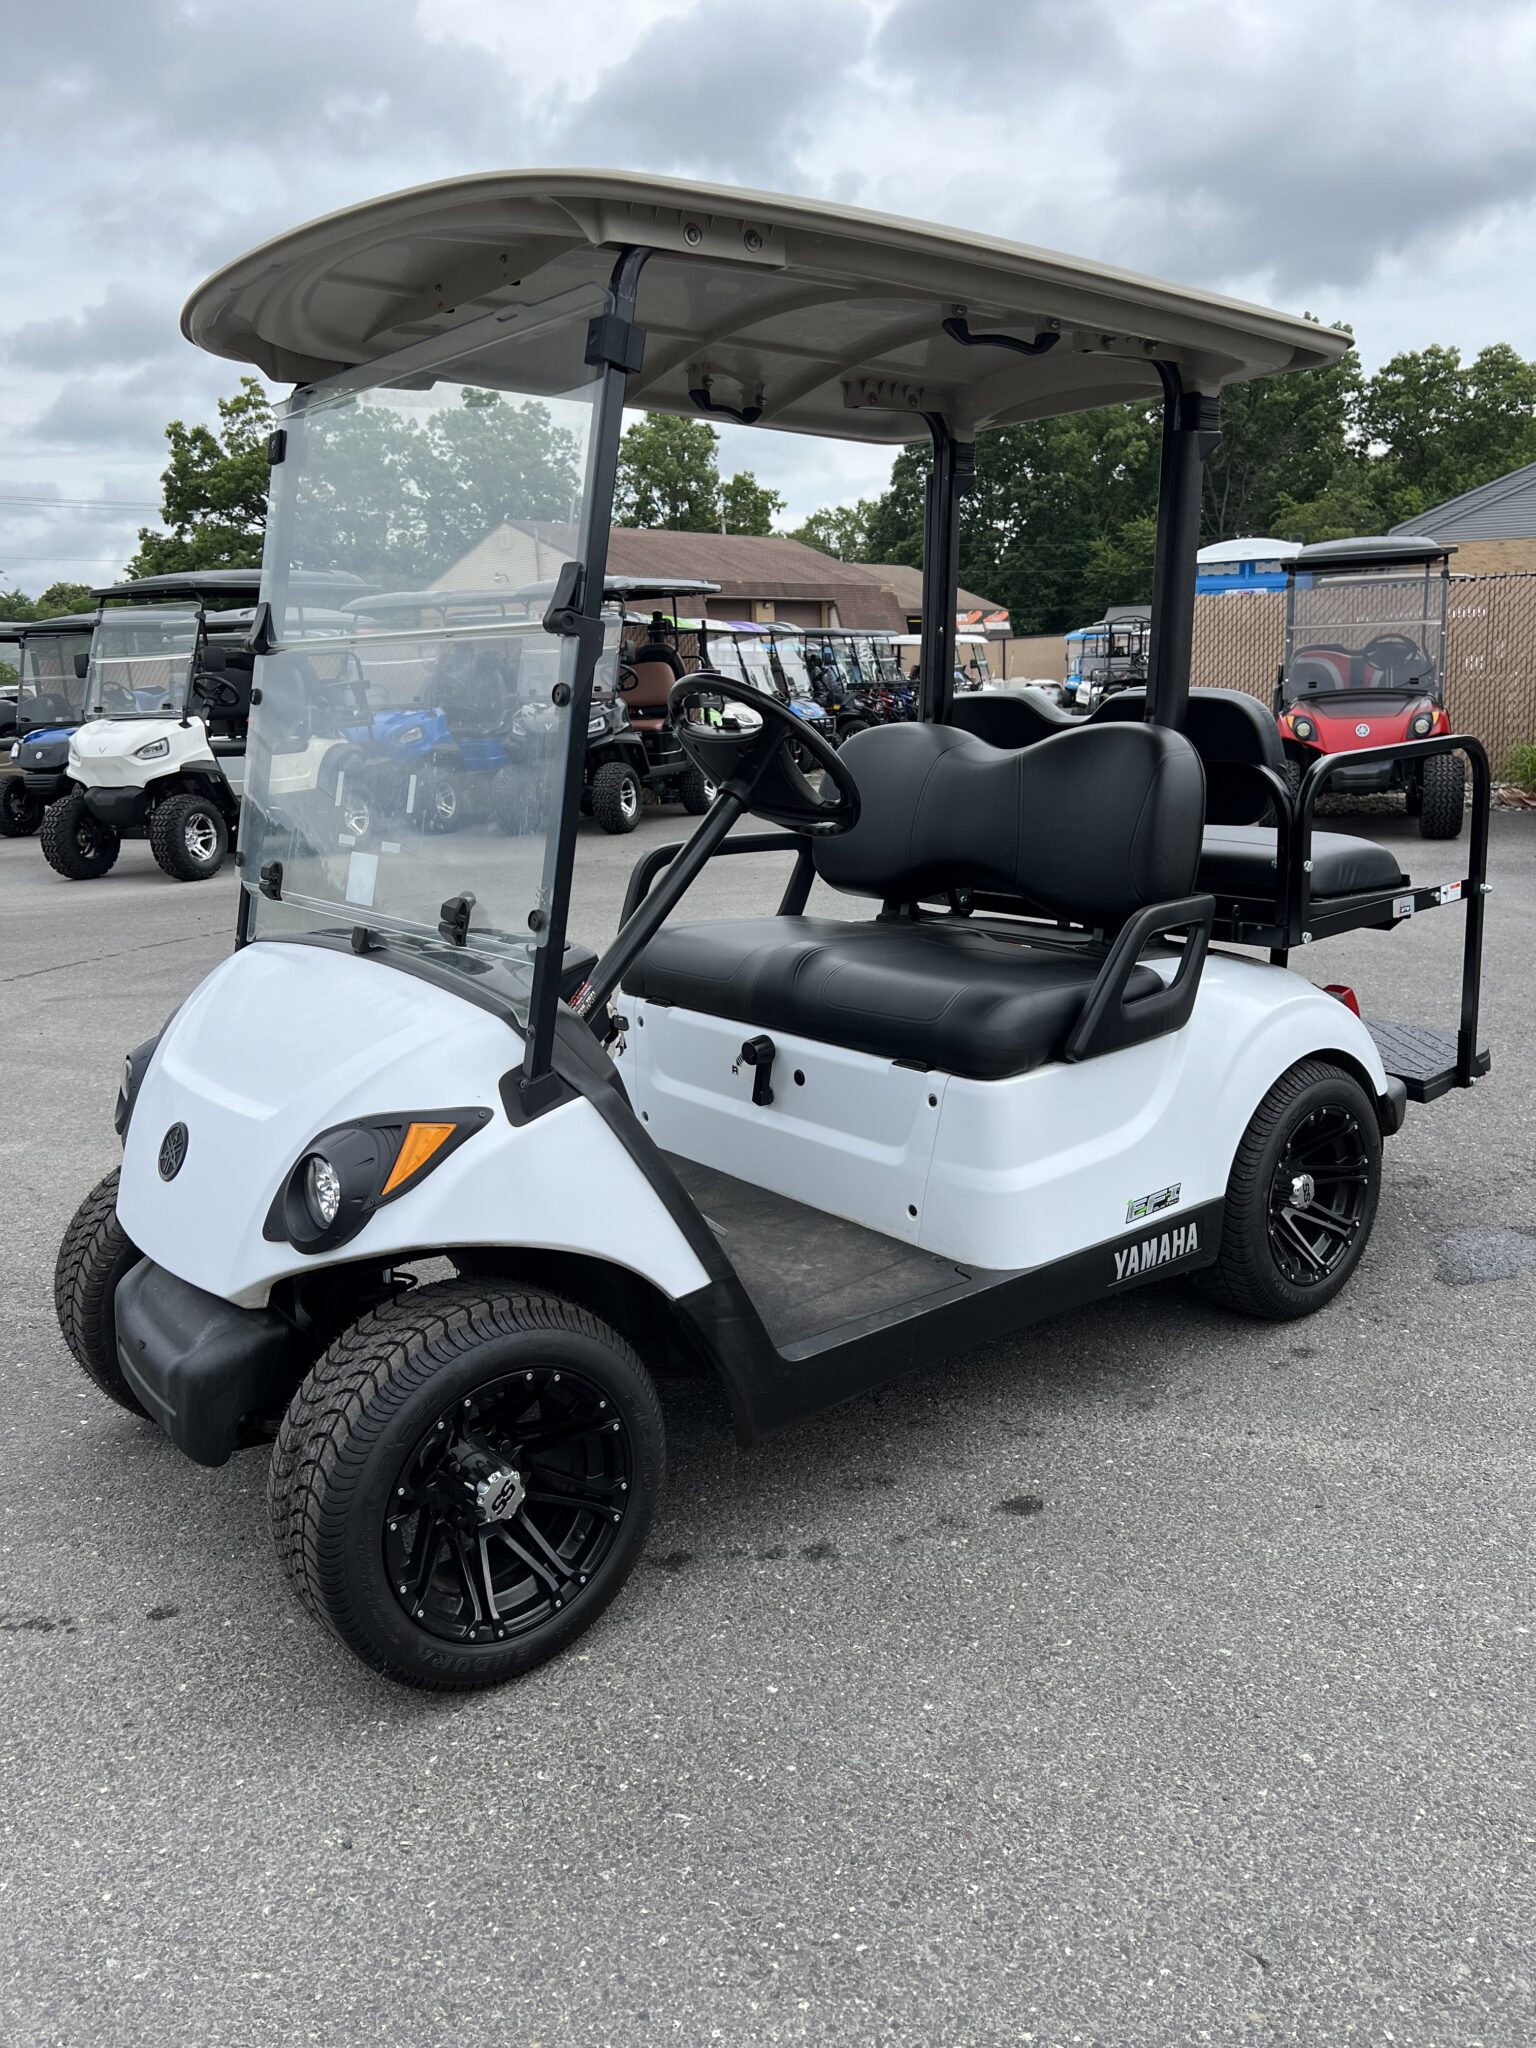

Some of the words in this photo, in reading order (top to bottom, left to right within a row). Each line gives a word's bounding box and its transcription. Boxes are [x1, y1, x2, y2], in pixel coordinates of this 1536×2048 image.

[731, 1064, 739, 1075] R
[1126, 1183, 1181, 1224] EFI
[1113, 1221, 1198, 1281] YAMAHA
[491, 1479, 516, 1516] SS
